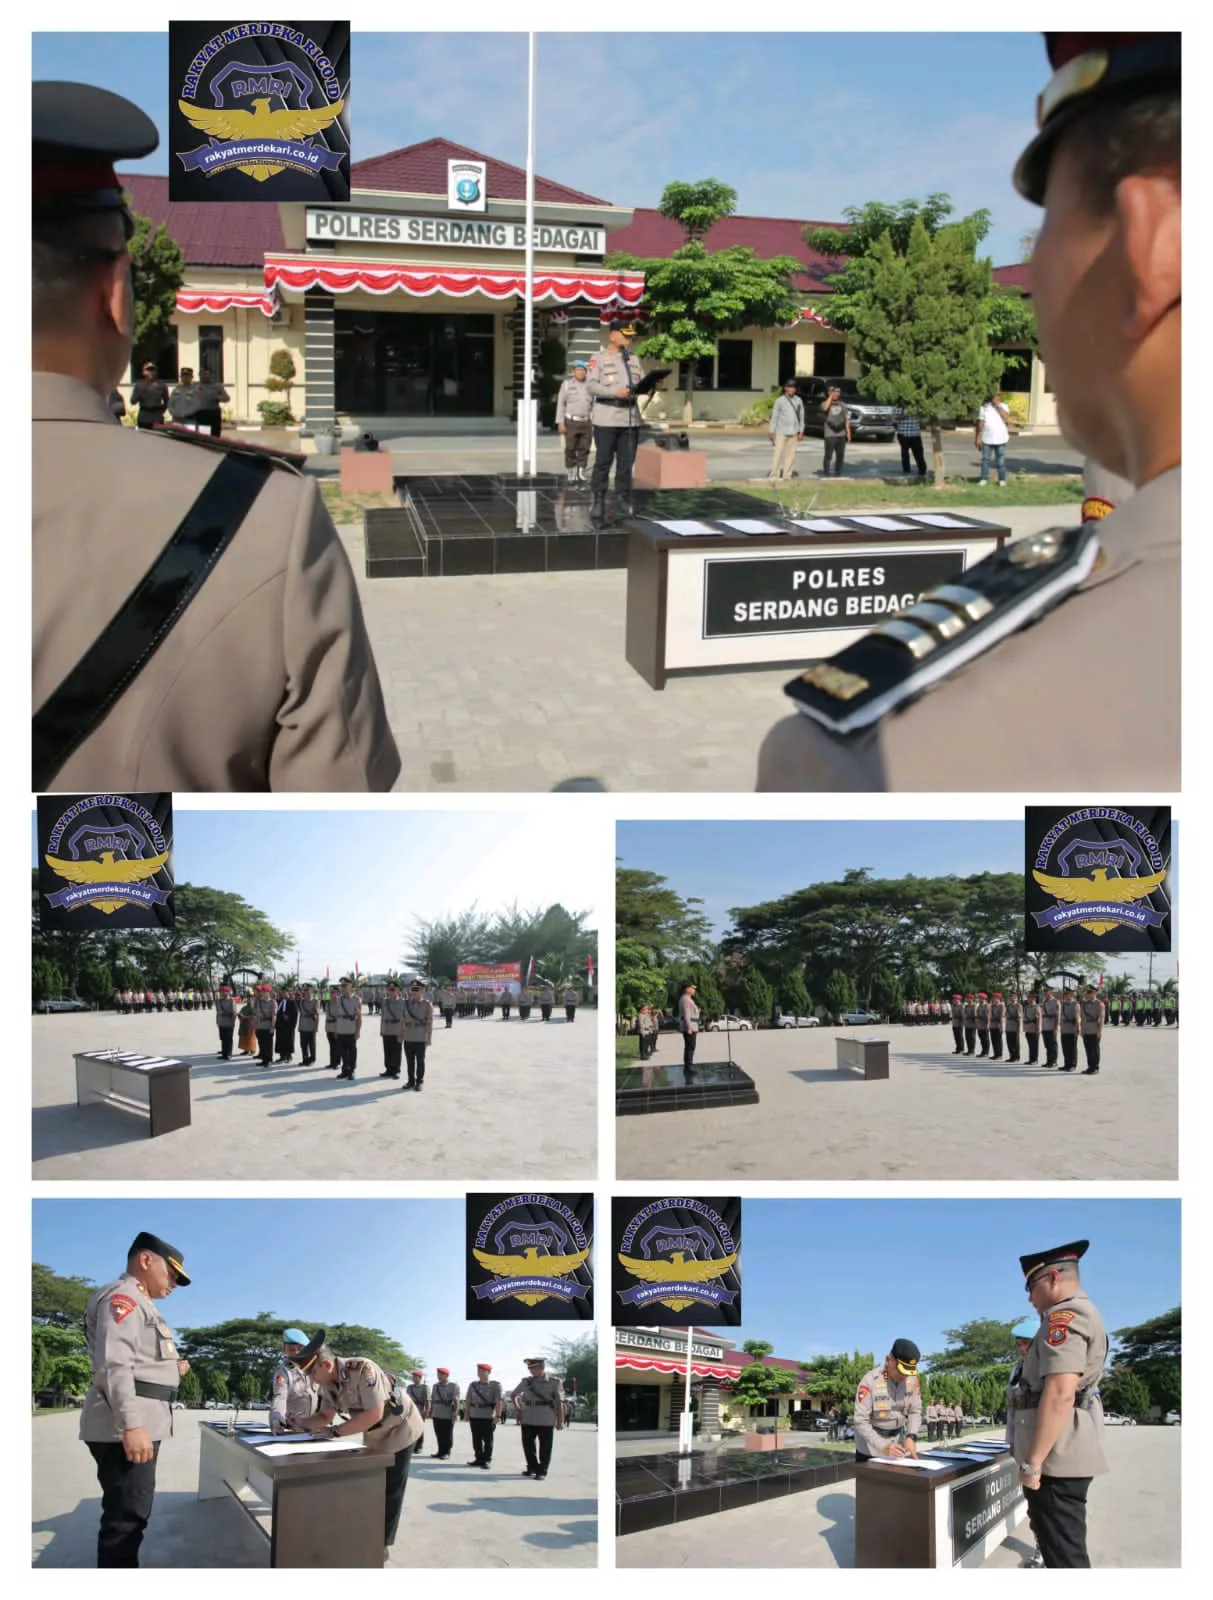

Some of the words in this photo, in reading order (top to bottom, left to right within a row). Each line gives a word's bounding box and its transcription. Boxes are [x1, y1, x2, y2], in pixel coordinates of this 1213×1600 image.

[315, 213, 401, 239] POLRES
[407, 219, 506, 246] SERDANG
[513, 226, 599, 251] BEDAGAI
[793, 567, 885, 590] POLRES
[733, 598, 838, 622] SERDANG
[846, 593, 926, 616] BEDAG
